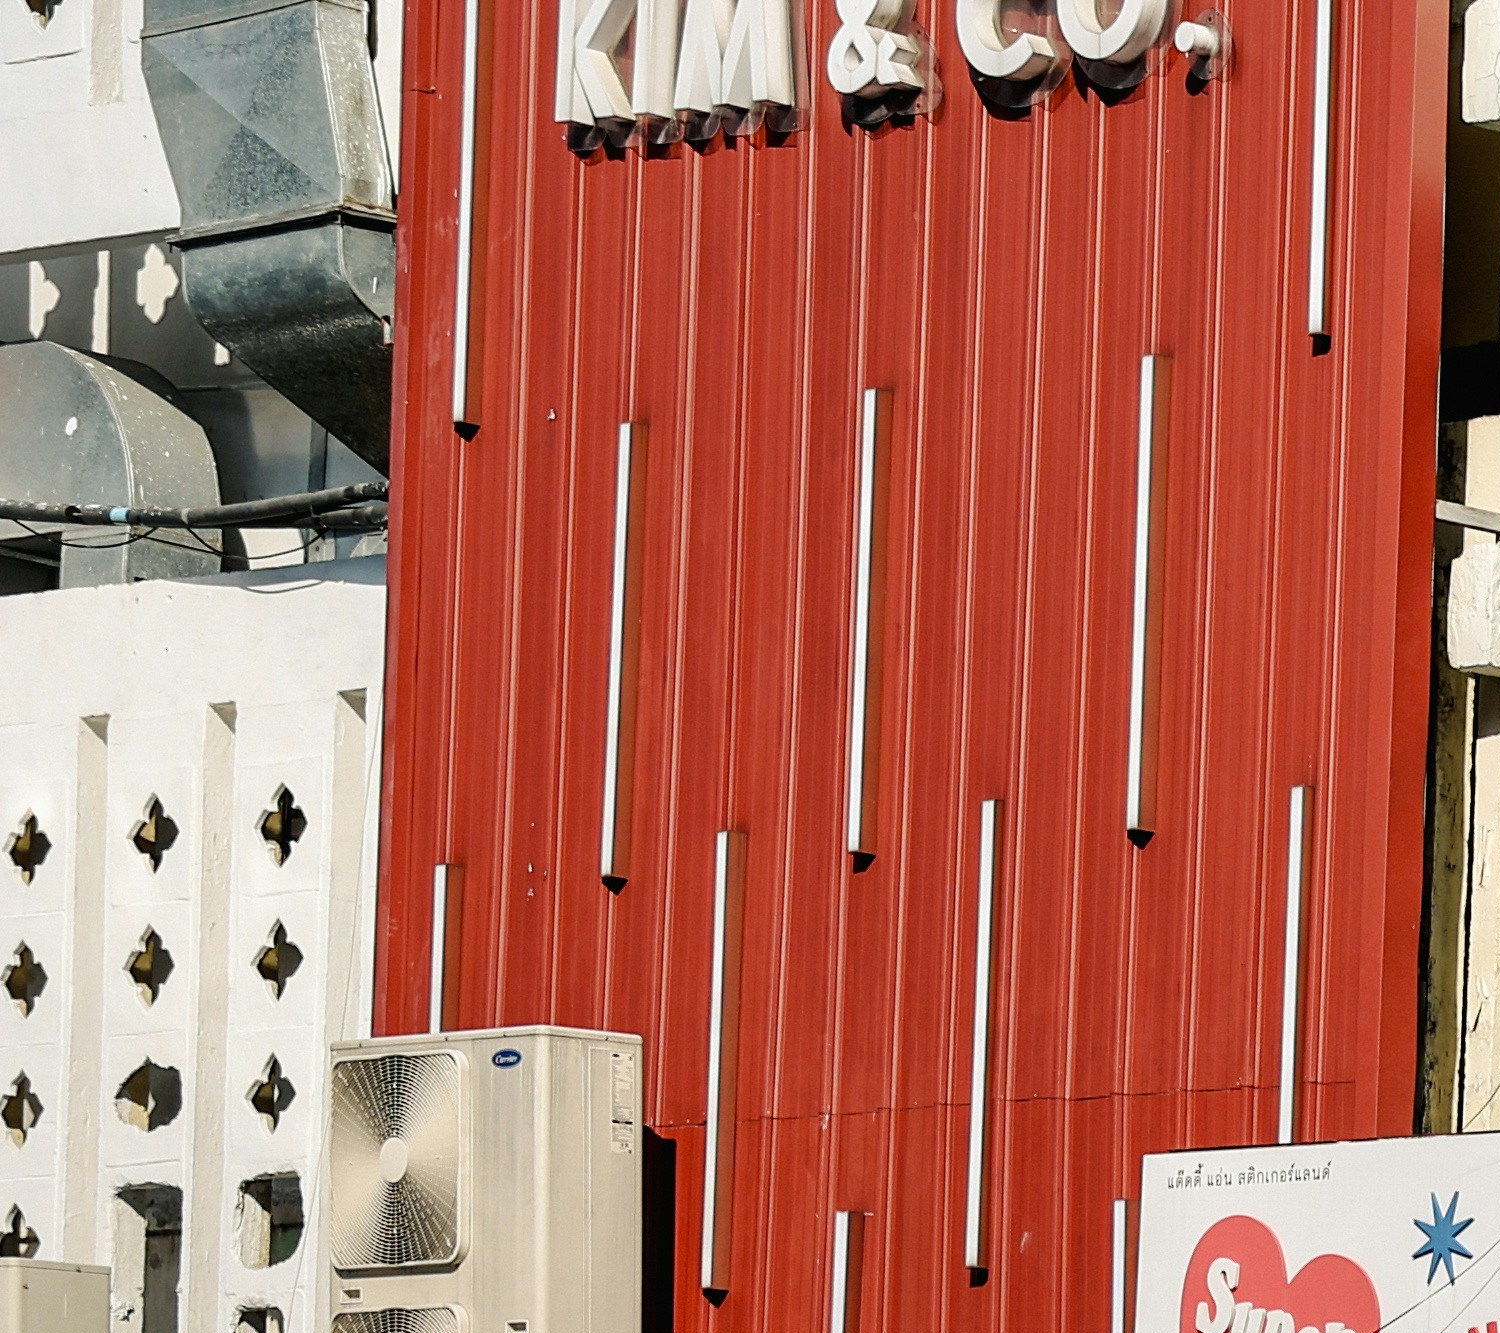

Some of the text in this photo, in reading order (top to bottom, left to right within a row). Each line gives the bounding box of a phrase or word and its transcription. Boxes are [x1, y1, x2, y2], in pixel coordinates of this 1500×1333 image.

[826, 0, 922, 95] &
[1238, 1160, 1332, 1185] สติกเกอร์แลนด์
